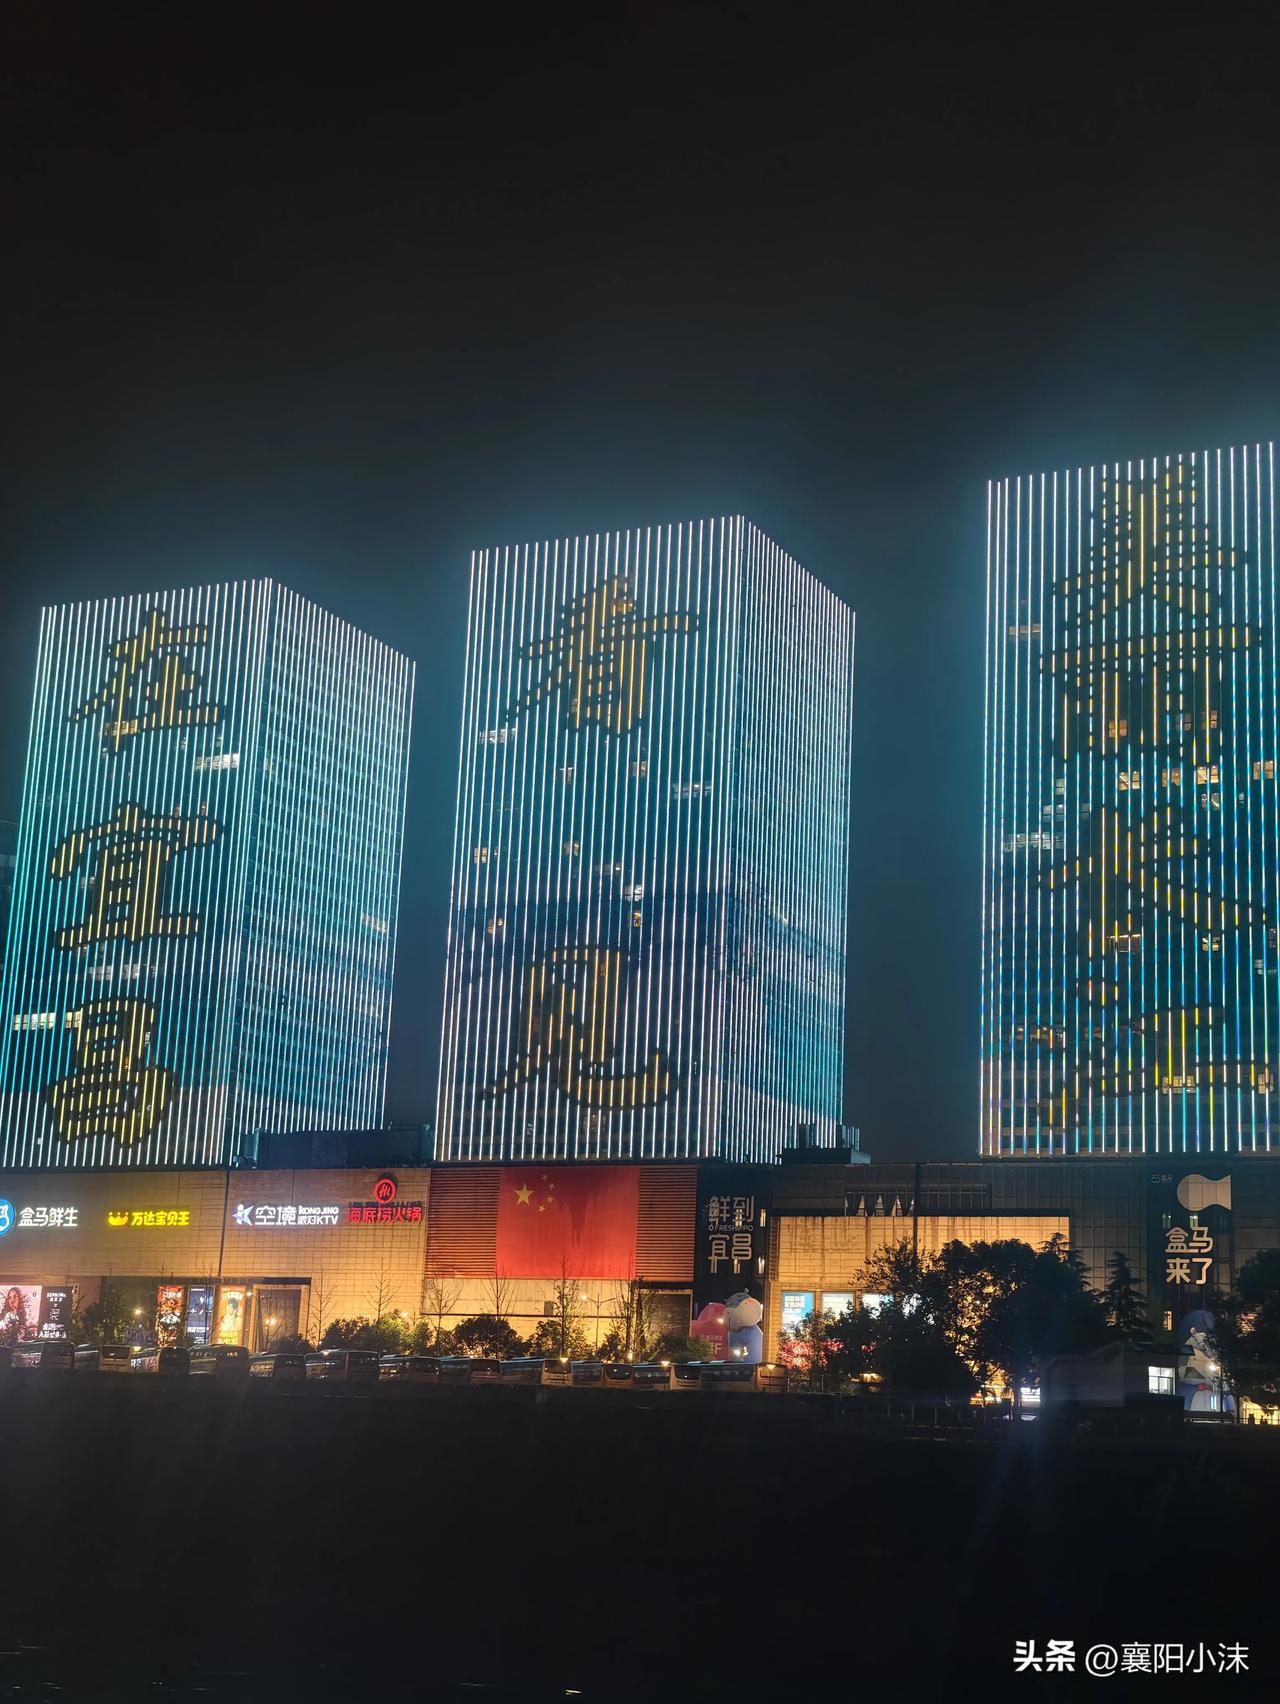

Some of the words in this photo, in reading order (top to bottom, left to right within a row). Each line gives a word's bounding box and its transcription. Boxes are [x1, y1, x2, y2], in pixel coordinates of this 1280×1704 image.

[480, 574, 704, 1108] 看见
[46, 606, 229, 1148] 在宜昌
[18, 1206, 79, 1227] 盒马鲜生
[130, 1210, 191, 1227] 万达宝贝王
[255, 1205, 296, 1226] 空境
[346, 1206, 423, 1224] 海底捞火锅
[708, 1195, 755, 1226] 鲜到
[708, 1233, 752, 1260] 宜昌
[1165, 1226, 1214, 1253] 盒马
[1166, 1257, 1213, 1285] 来了
